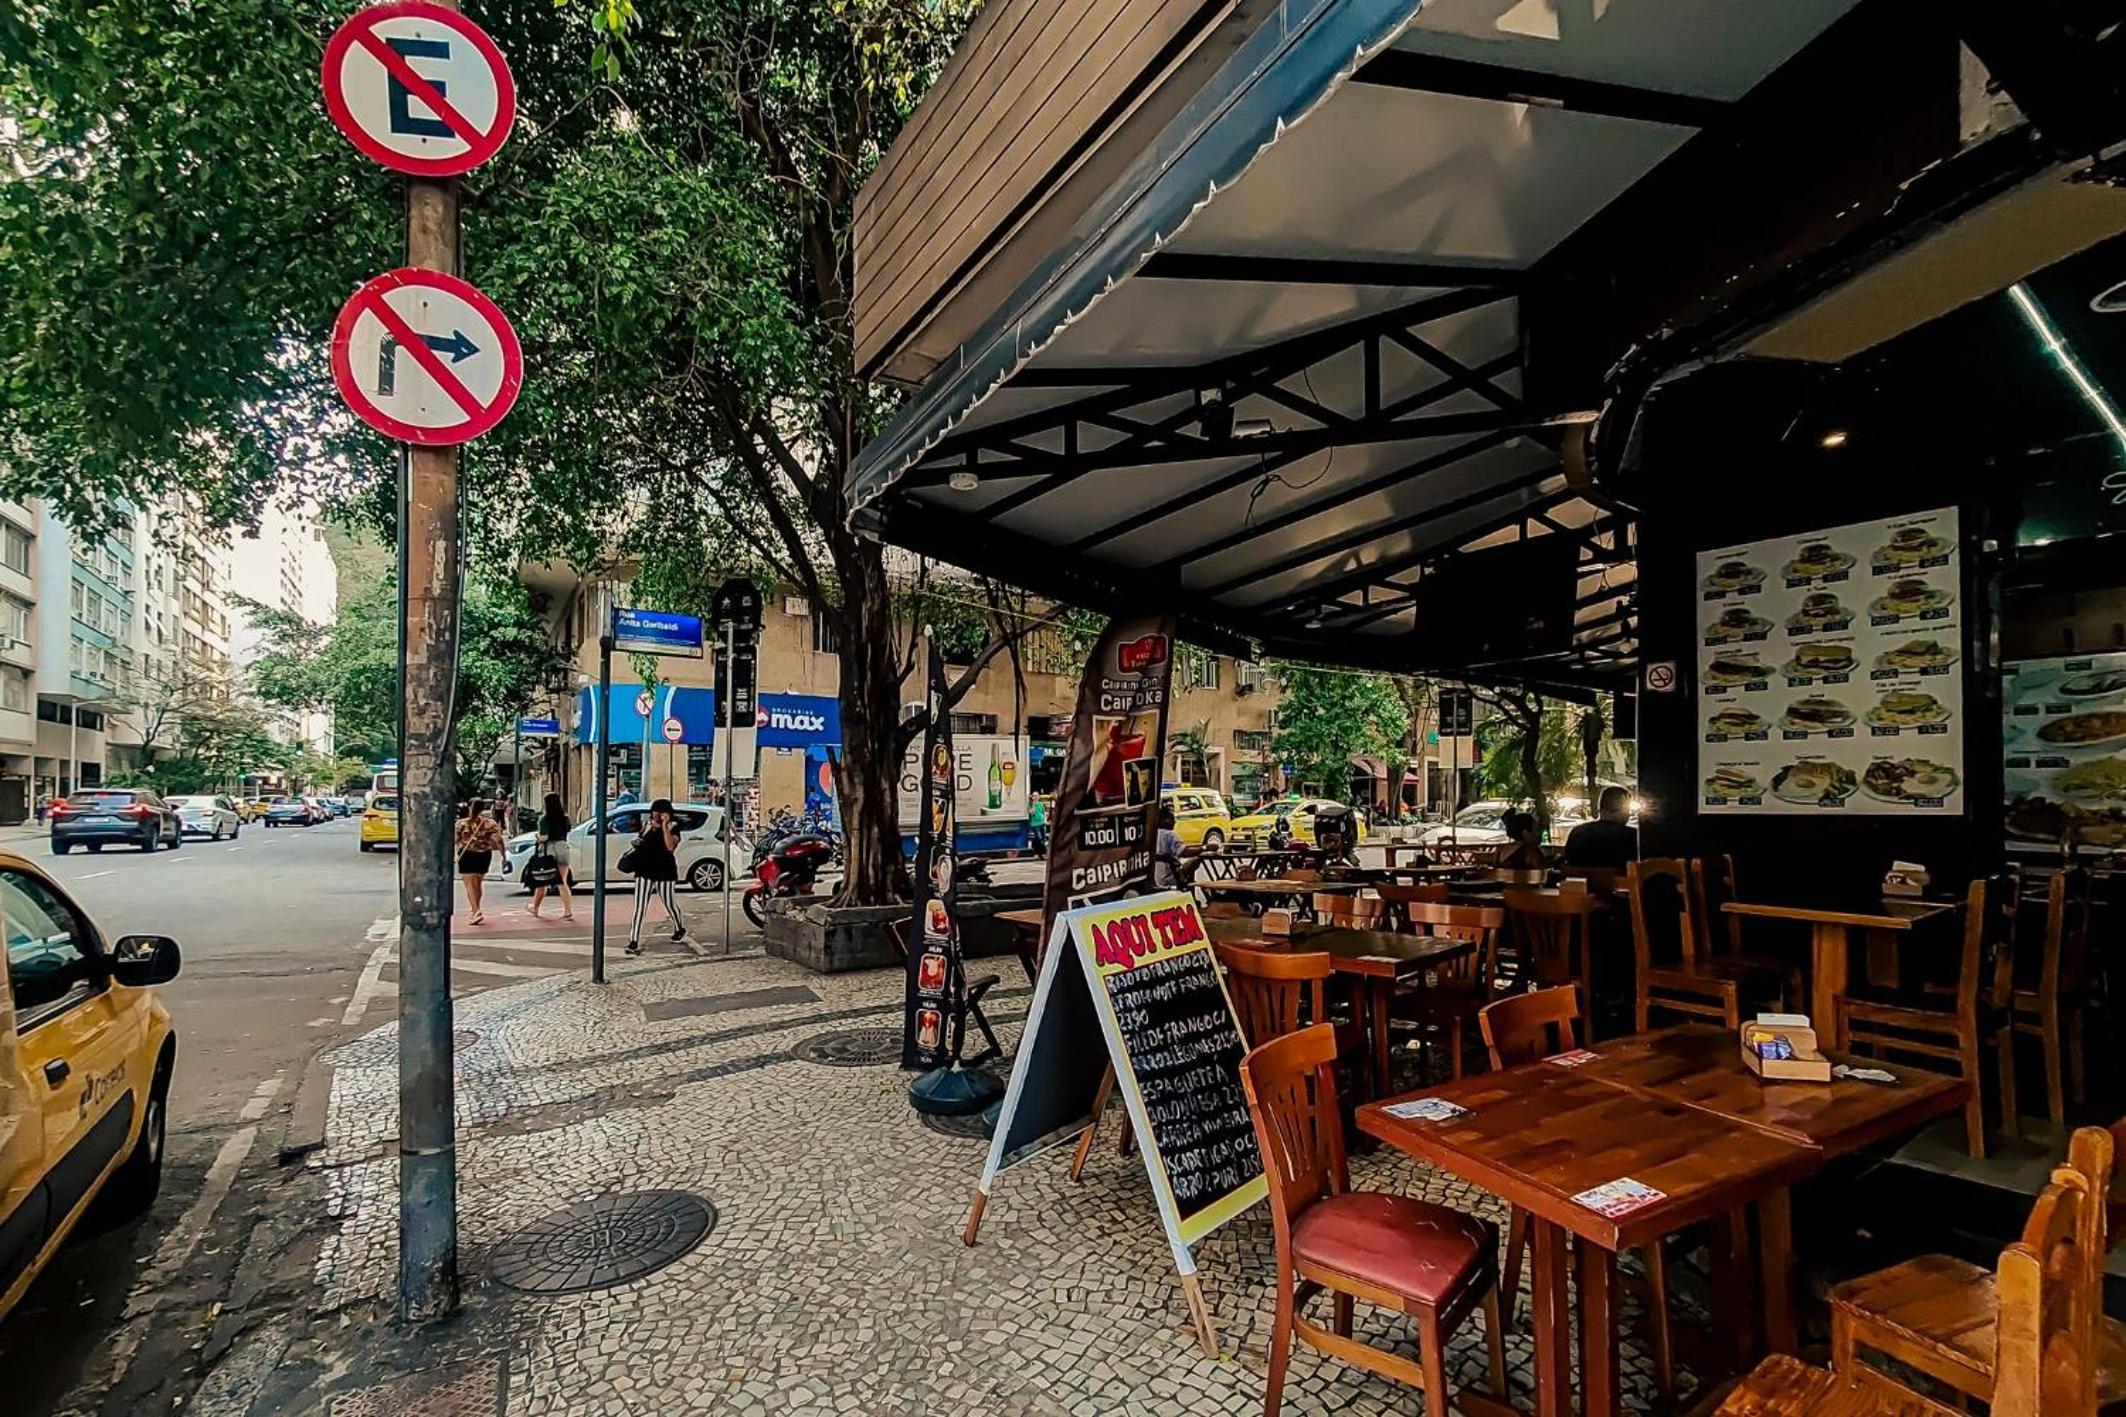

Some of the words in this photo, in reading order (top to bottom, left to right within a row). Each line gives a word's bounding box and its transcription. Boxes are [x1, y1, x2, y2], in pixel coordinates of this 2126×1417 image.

[386, 36, 456, 139] E
[642, 620, 678, 630] Garibaldi
[771, 713, 825, 731] max
[1092, 914, 1157, 969] AQUI
[1151, 904, 1204, 949] TEM
